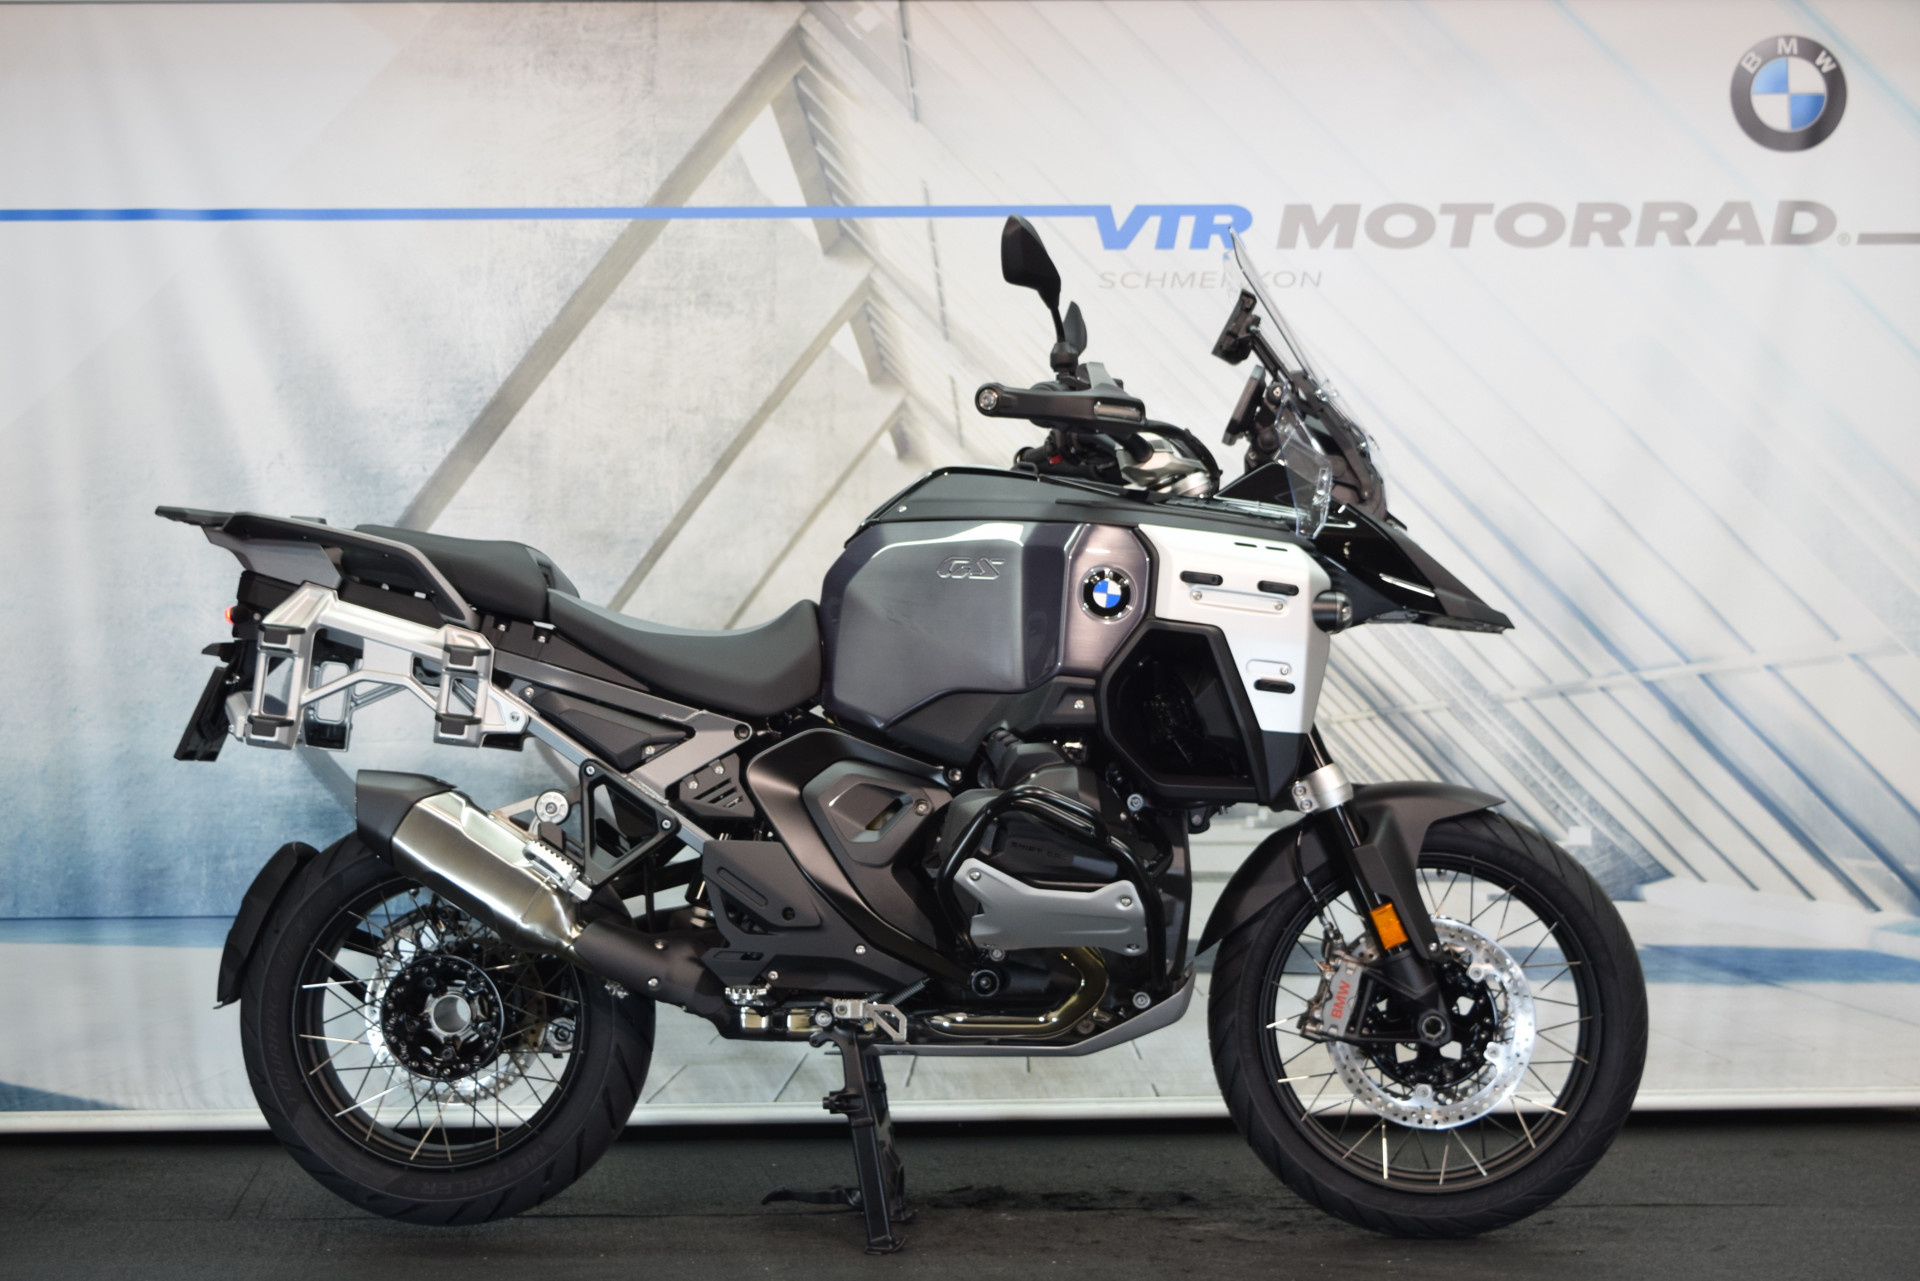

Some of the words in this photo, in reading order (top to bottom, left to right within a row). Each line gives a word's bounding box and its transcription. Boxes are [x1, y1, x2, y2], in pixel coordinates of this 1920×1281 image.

[1740, 37, 1837, 75] BMW
[1095, 204, 1253, 250] VTR
[1098, 270, 1322, 290] SCHMEON
[936, 555, 1005, 580] GS
[1330, 980, 1351, 1019] BMW
[422, 1142, 549, 1194] METZELER
